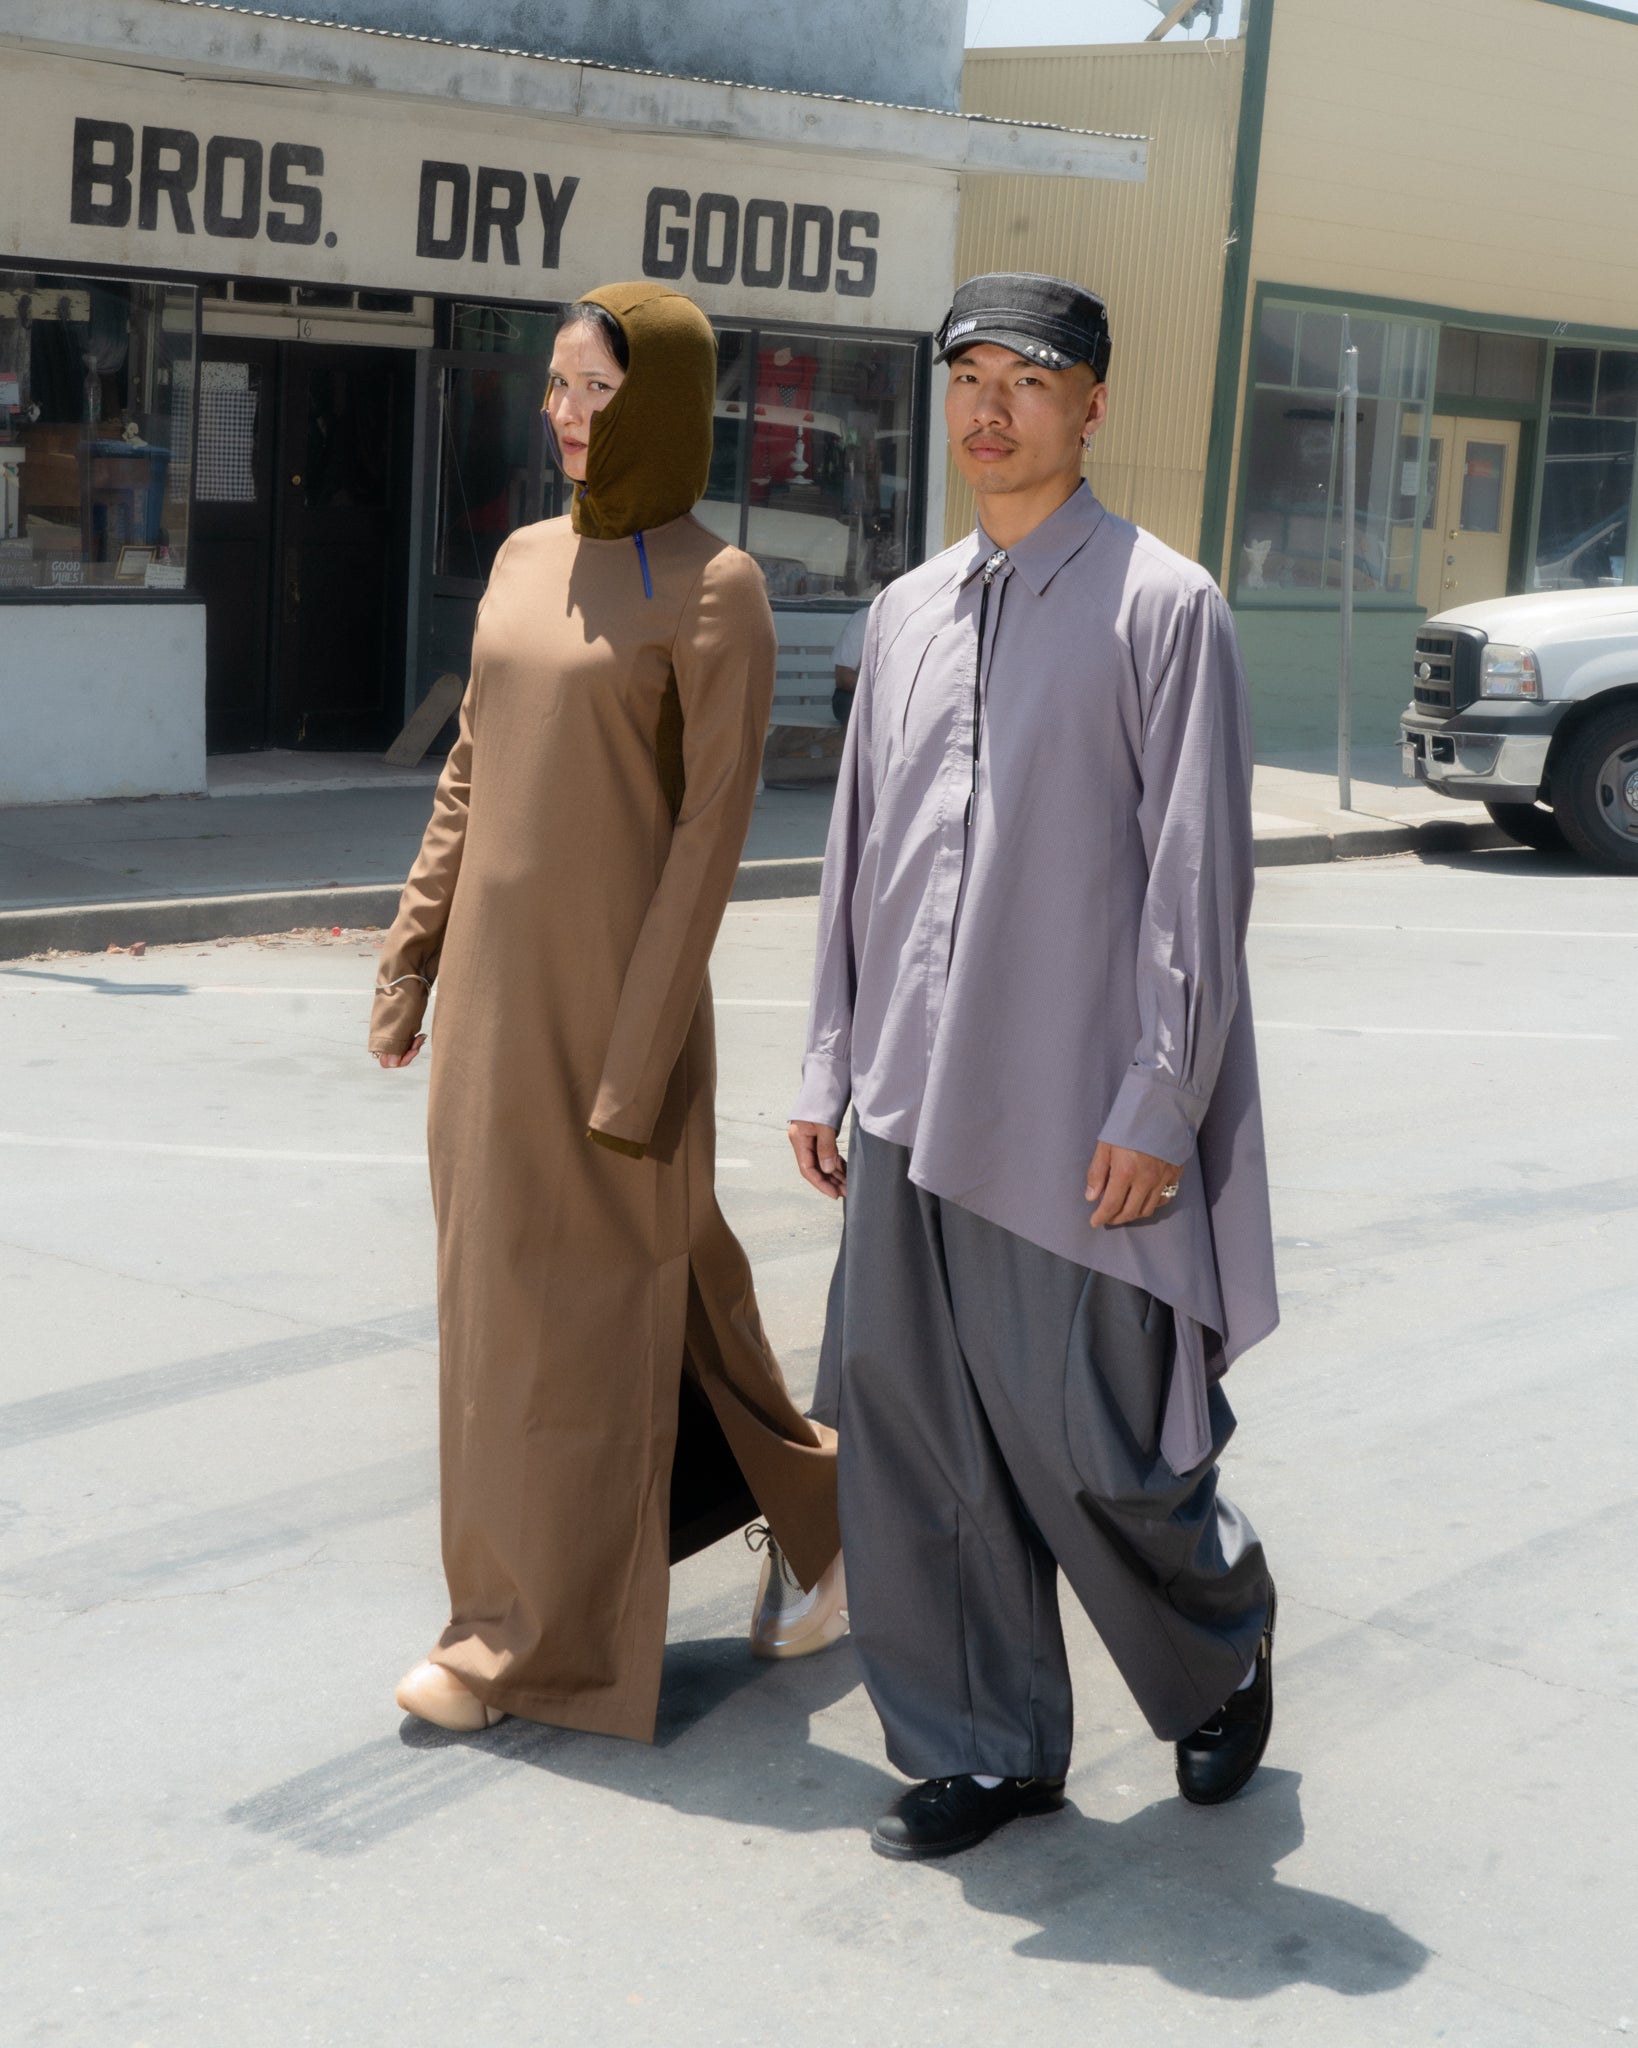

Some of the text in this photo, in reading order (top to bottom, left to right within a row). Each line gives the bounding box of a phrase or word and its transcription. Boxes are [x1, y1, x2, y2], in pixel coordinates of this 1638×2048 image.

[71, 117, 880, 298] BROS. DRY GOODS
[297, 318, 312, 339] 16
[52, 560, 81, 571] GOOD
